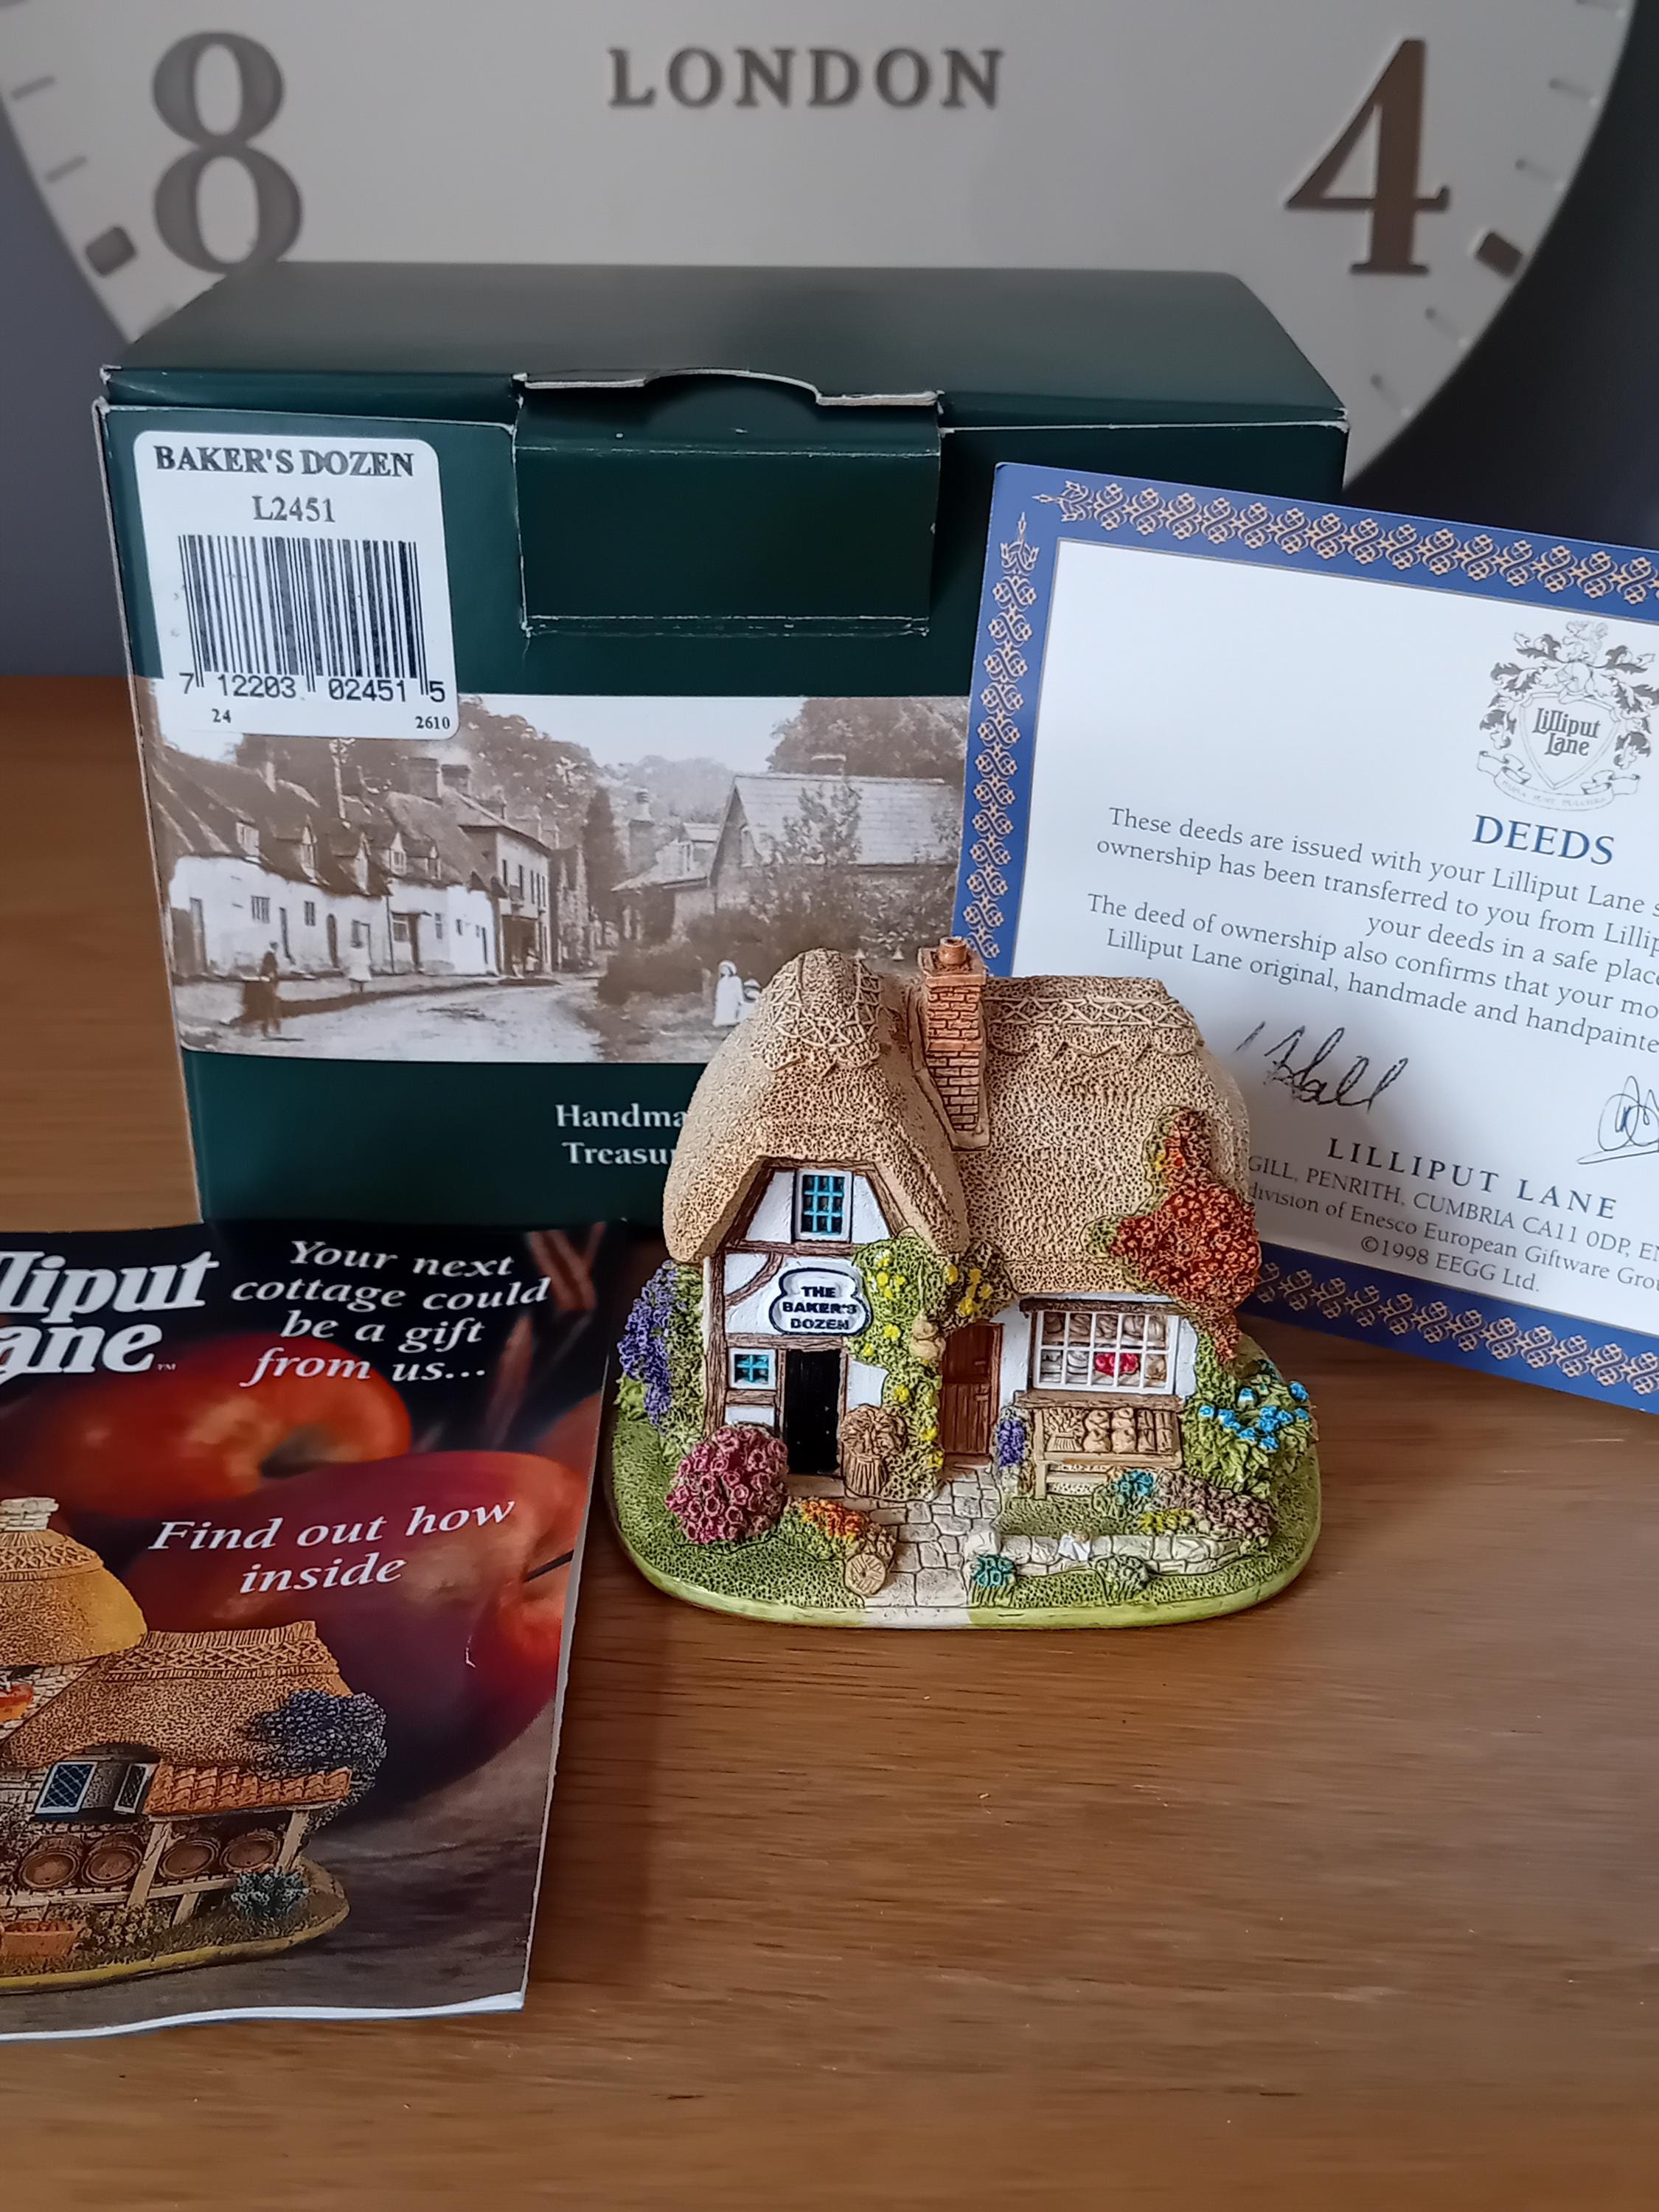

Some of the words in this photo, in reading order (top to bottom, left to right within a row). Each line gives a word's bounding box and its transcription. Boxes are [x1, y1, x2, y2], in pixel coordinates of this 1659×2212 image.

[607, 46, 1004, 109] LONDON
[153, 31, 302, 275] 8
[1284, 37, 1450, 277] 4
[153, 445, 294, 475] BAKER'S
[300, 450, 414, 477] DOZEN
[251, 495, 335, 523] L2451
[179, 673, 194, 694] 7
[218, 675, 296, 698] 12203
[328, 678, 406, 702] 02451
[430, 681, 445, 703] 5
[212, 709, 232, 723] 24
[416, 716, 451, 730] 2610
[1531, 708, 1601, 738] Lilliput
[1544, 733, 1590, 757] Lane
[1109, 807, 1172, 834] These
[1180, 818, 1243, 845] deeds
[1250, 834, 1284, 851] are
[1291, 835, 1363, 863] issued
[1371, 851, 1422, 874] with
[1427, 861, 1485, 883] your
[1492, 867, 1579, 902] Lilliput
[1587, 886, 1645, 914] Lane
[1472, 814, 1615, 865] DEEDS
[1096, 840, 1211, 875] ownership
[1219, 854, 1256, 877] has
[1263, 860, 1315, 888] been
[1324, 875, 1447, 911] transferred
[1456, 899, 1478, 917] to
[1484, 905, 1529, 927] you
[1538, 909, 1595, 939] from
[1088, 893, 1127, 917] The
[1134, 902, 1186, 929] deed
[1192, 914, 1217, 933] of
[1221, 922, 1337, 961] ownership
[1343, 941, 1387, 964] also
[1395, 956, 1496, 987] confirms
[1504, 972, 1549, 998] that
[1555, 986, 1613, 1009] your
[1621, 998, 1659, 1019] mo
[1366, 917, 1421, 939] your
[1427, 924, 1495, 953] deeds
[1501, 938, 1524, 959] in
[1533, 948, 1545, 963] a
[1552, 950, 1598, 973] safe
[1107, 928, 1183, 961] Lilliput
[1192, 944, 1242, 970] Lane
[1250, 959, 1339, 992] original,
[1348, 973, 1467, 1014] handmade
[1474, 1001, 1518, 1024] and
[1526, 1007, 1659, 1054] handpainte
[1327, 1138, 1499, 1192] LILLIPUT
[1517, 1179, 1616, 1219] LANE
[1413, 1192, 1514, 1229] CUMBRIA
[1523, 1217, 1576, 1242] CA11
[291, 1240, 398, 1269] Your
[412, 1256, 514, 1277] next
[1326, 1201, 1346, 1217] of
[1351, 1206, 1417, 1234] Enesco
[1424, 1222, 1517, 1254] European
[1525, 1246, 1610, 1279] Giftware
[801, 1286, 835, 1298] THE
[1436, 1253, 1495, 1280] EEGG
[1502, 1268, 1539, 1292] Ltd.
[231, 1279, 406, 1312] cottage
[422, 1276, 552, 1310] could
[782, 1302, 857, 1314] BAKER'S
[280, 1310, 338, 1338] be
[355, 1324, 385, 1342] a
[397, 1318, 485, 1353] gift
[790, 1318, 849, 1329] DOZEN
[0, 1324, 162, 1385] ane
[240, 1347, 370, 1387] from
[392, 1362, 485, 1382] us...
[148, 1517, 283, 1550] Find
[297, 1515, 387, 1548] out
[405, 1500, 515, 1537] how
[240, 1552, 406, 1593] inside
